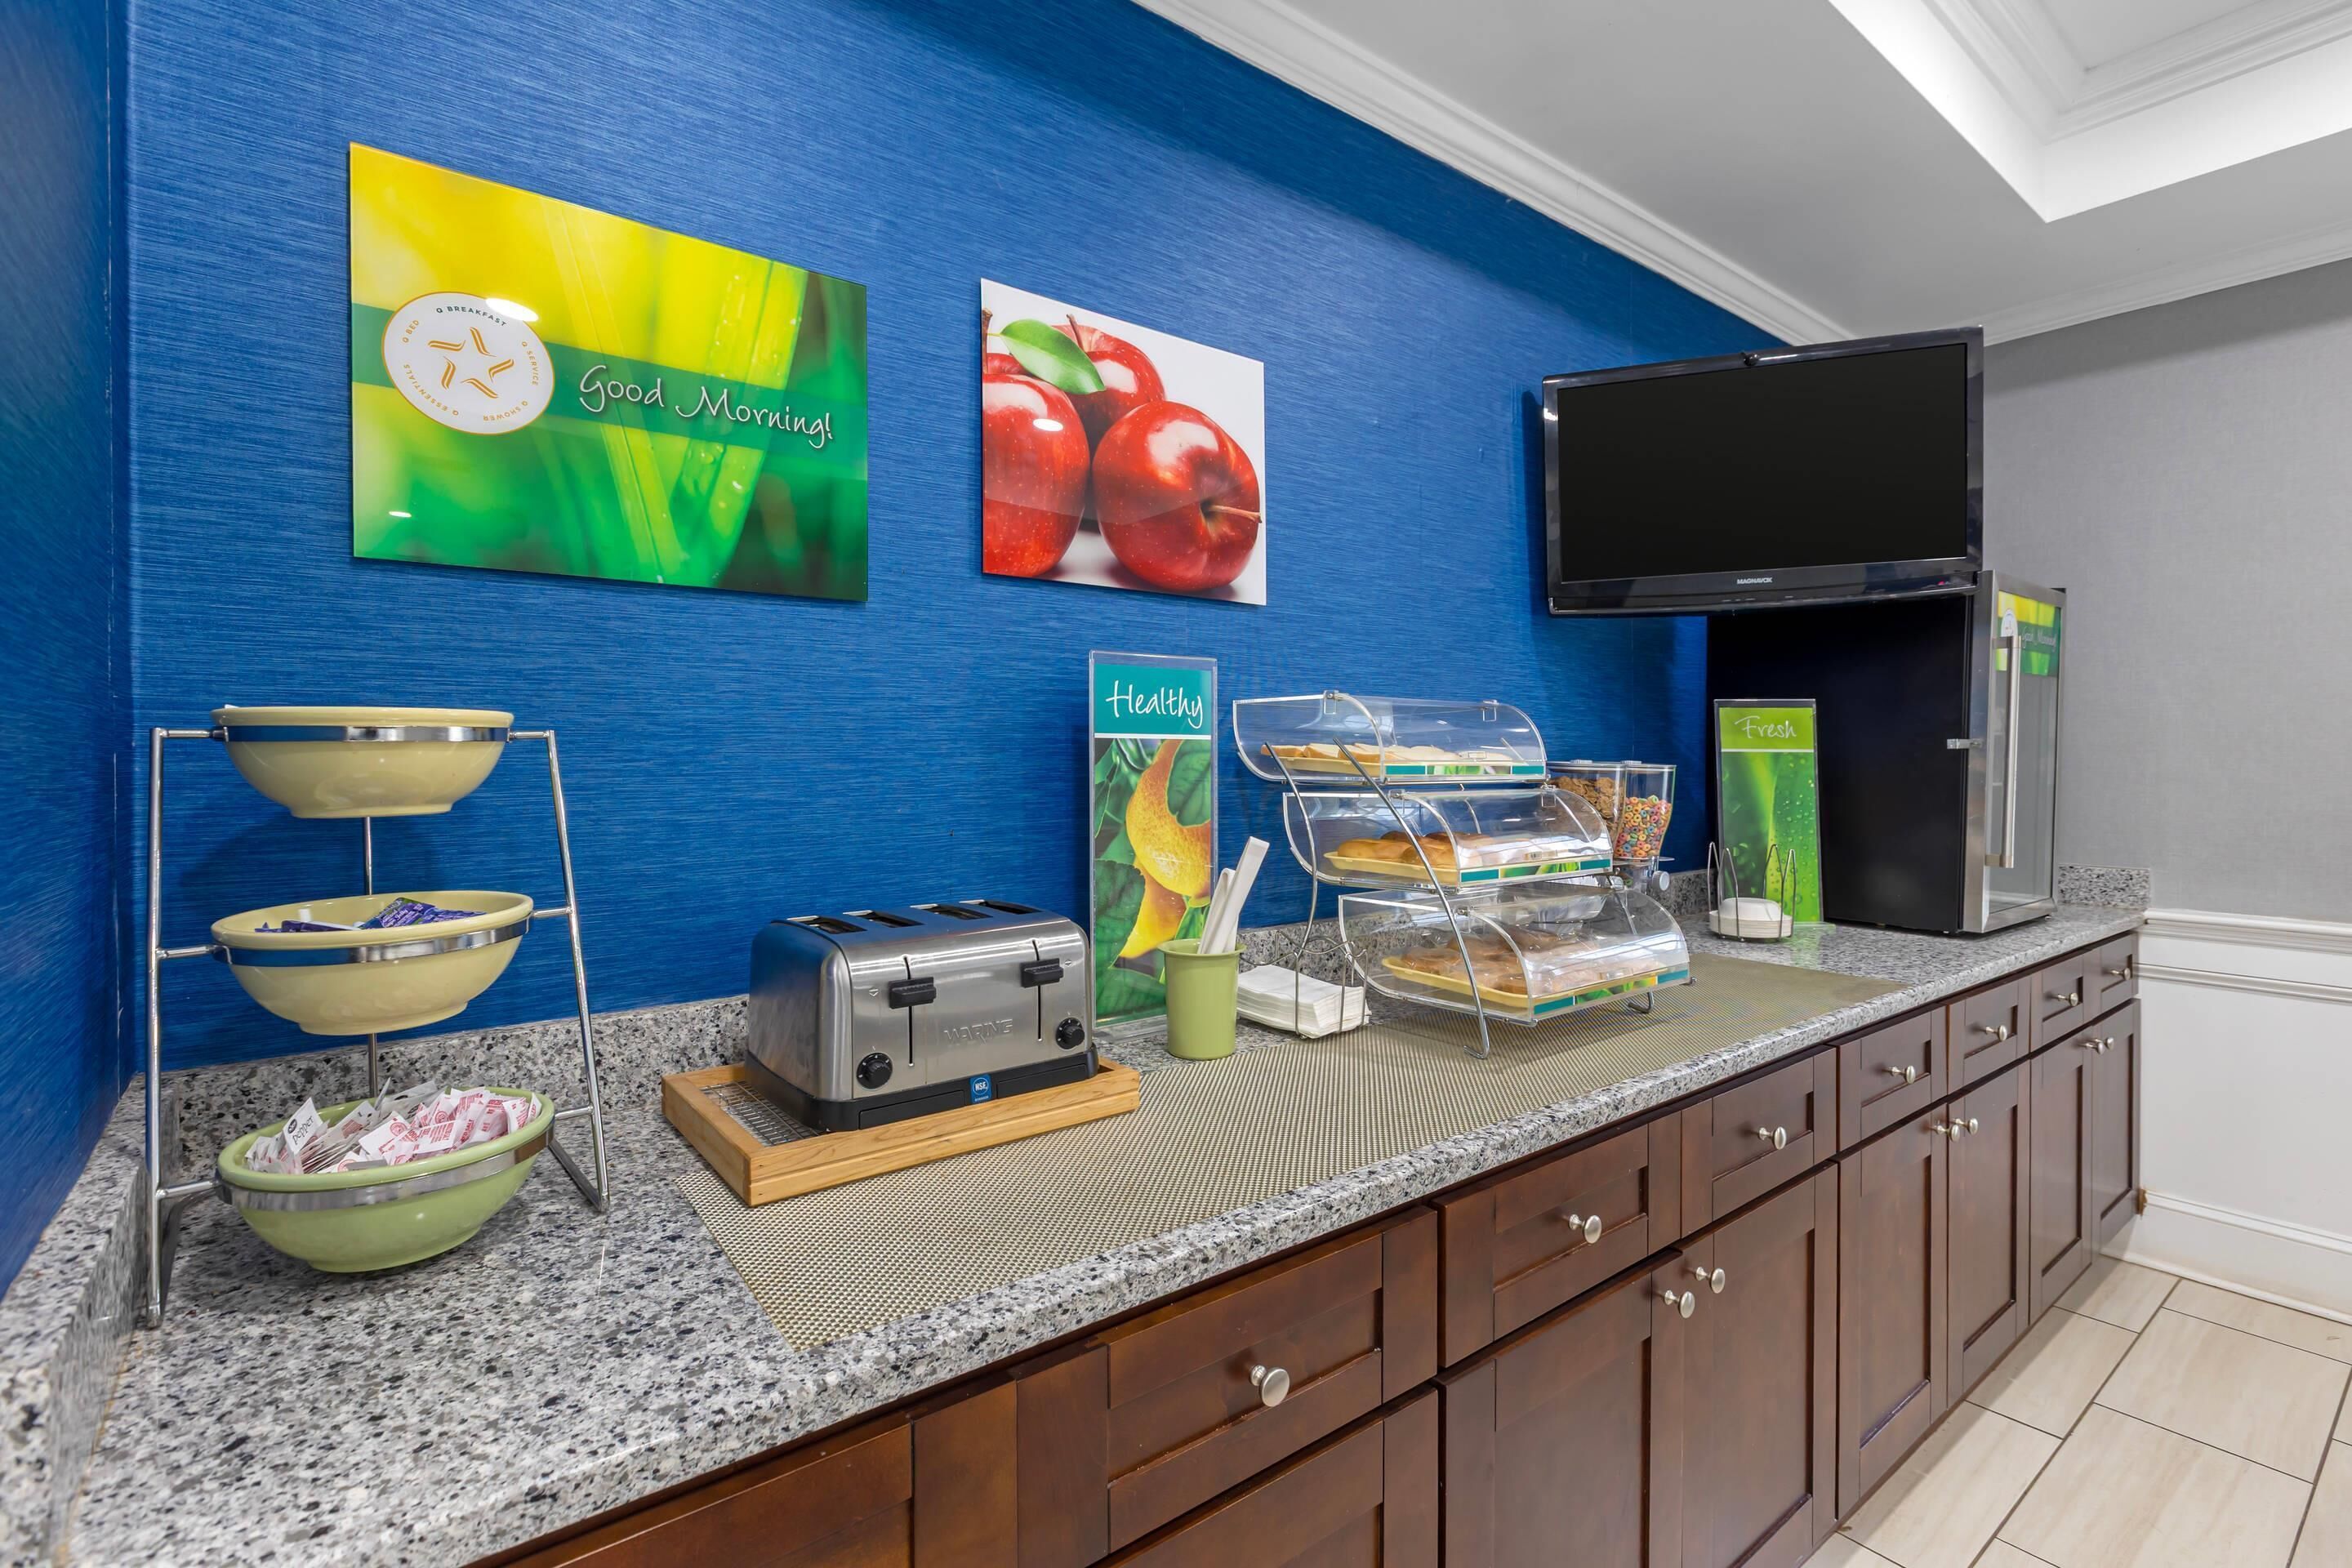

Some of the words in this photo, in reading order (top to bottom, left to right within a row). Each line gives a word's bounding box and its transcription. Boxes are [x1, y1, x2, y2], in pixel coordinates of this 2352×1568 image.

[406, 319, 420, 335] BED
[447, 305, 507, 327] BREAKFAST
[527, 350, 539, 386] SERVICE
[403, 363, 448, 412] ESSENTIALS
[483, 406, 522, 421] SHOWER
[579, 364, 666, 412] Good
[675, 386, 834, 449] Morning!
[1736, 577, 1773, 585] MAGNAVOX
[1105, 679, 1203, 729] Healthy
[1734, 715, 1797, 738] Fresh
[943, 1018, 1013, 1045] WARING
[292, 1116, 314, 1145] pepper
